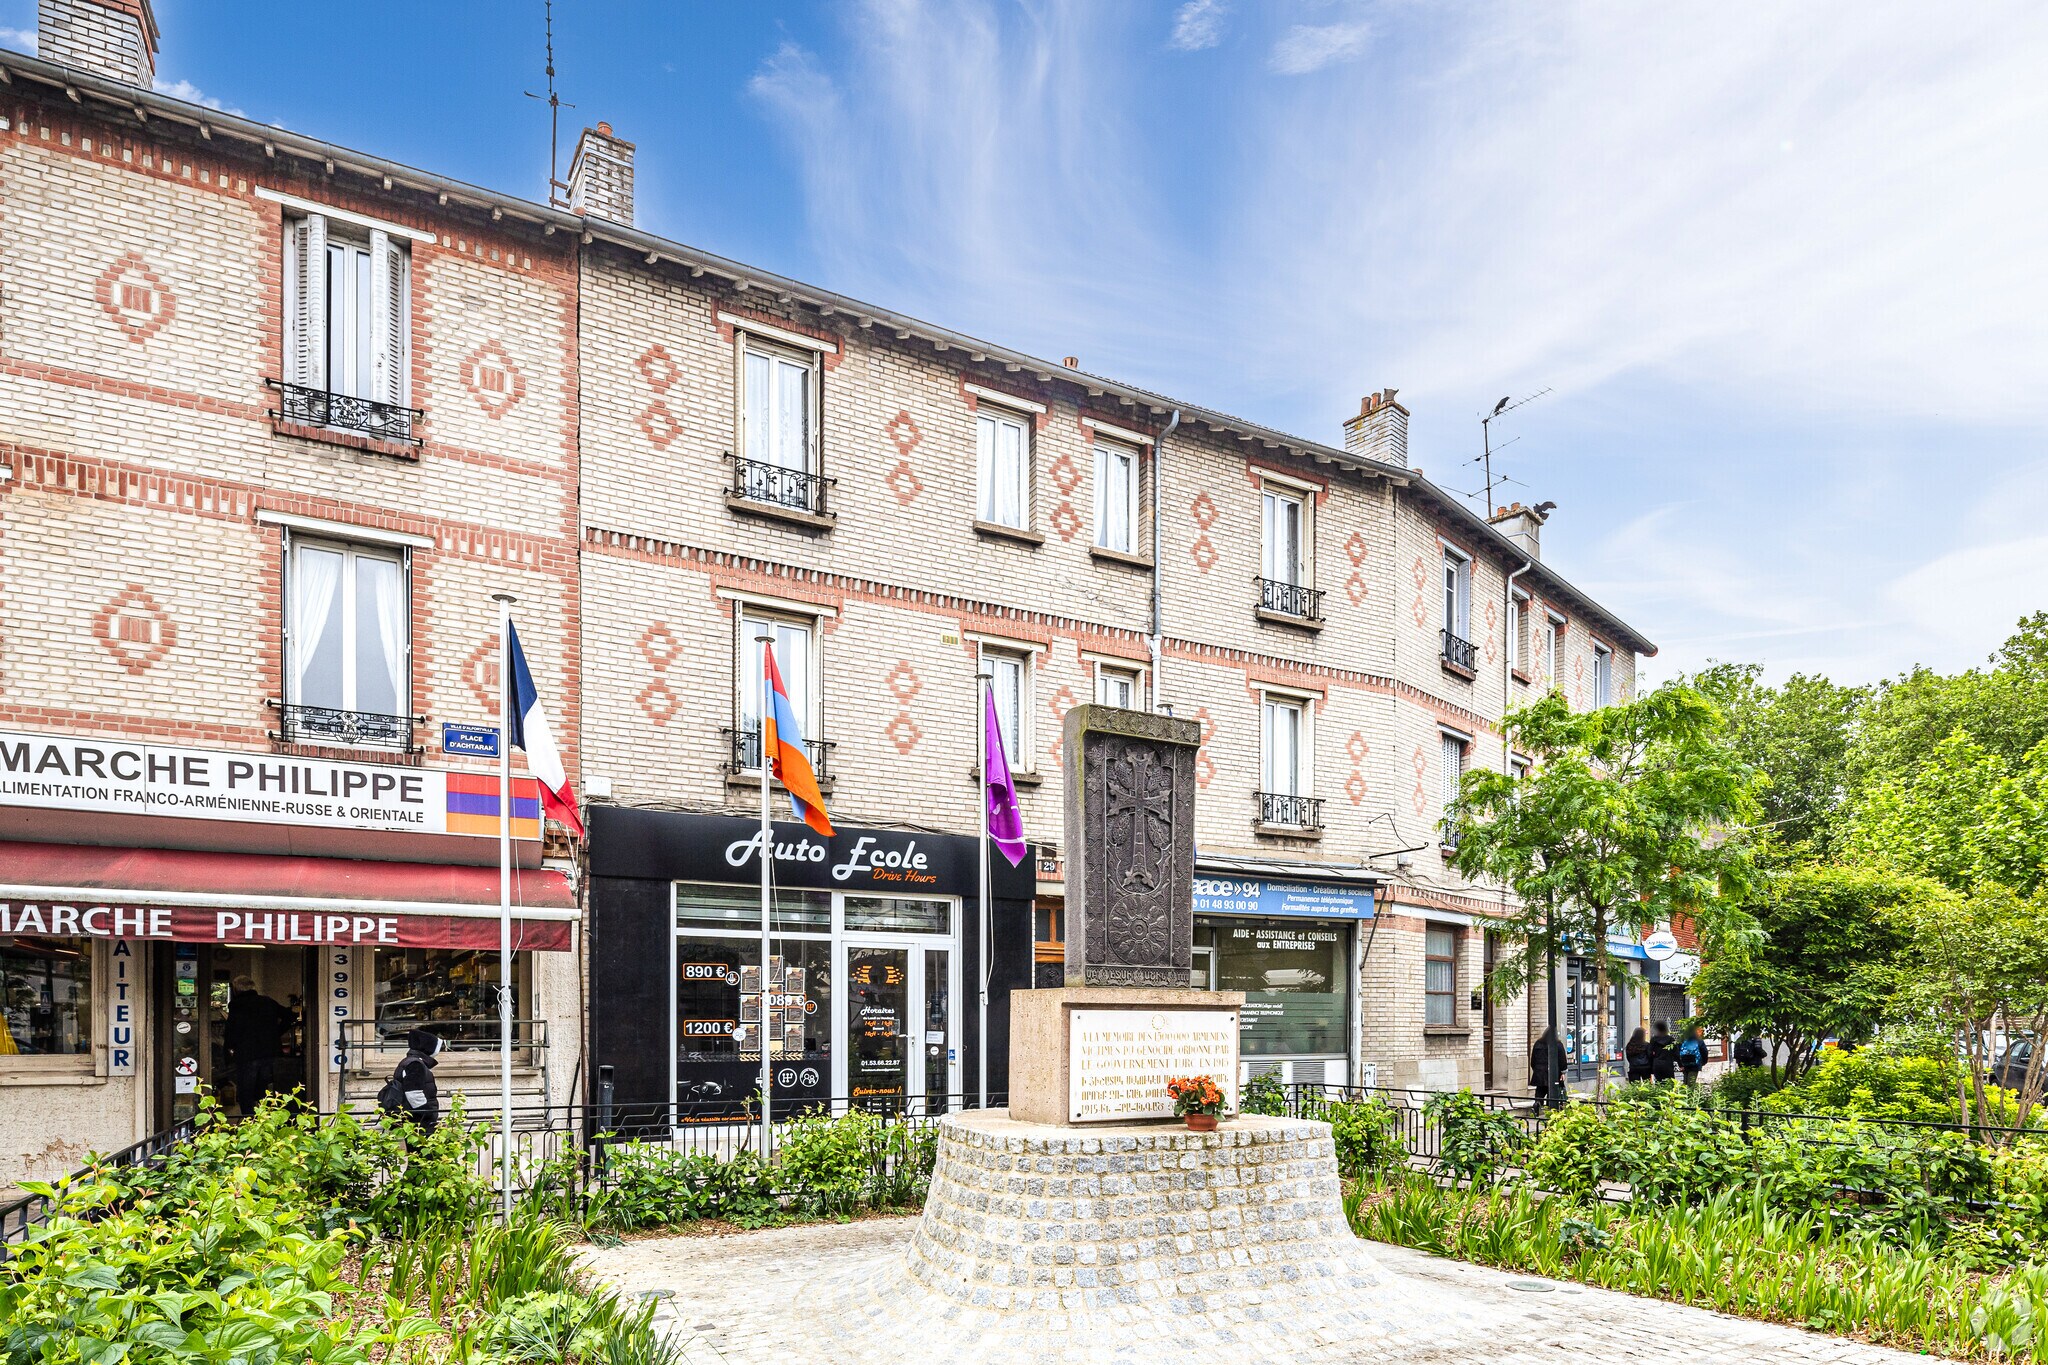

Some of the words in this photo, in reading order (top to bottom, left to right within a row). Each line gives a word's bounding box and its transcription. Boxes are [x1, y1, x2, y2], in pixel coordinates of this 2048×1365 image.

[449, 742, 494, 751] D'ACHTARAK
[0, 740, 210, 787] MARCHE
[228, 760, 424, 804] PHILIPPE
[0, 780, 109, 801] LIMENTATION
[113, 788, 333, 817] FRANCO-ARMÉNIENNE-RUSSE
[336, 805, 346, 818] &
[350, 806, 424, 823] ORIENTALE
[725, 829, 827, 868] Auto
[831, 836, 928, 882] Ecole
[1043, 861, 1055, 871] 29
[873, 868, 902, 882] Drive
[904, 870, 937, 884] Hours
[1267, 882, 1308, 894] Domiciliation
[1312, 885, 1338, 895] Création
[1339, 888, 1347, 896] de
[1348, 889, 1372, 897] sociétés
[1200, 898, 1210, 909] 01
[1212, 899, 1223, 909] 48
[1223, 900, 1235, 910] 93
[1236, 900, 1247, 910] 00
[1247, 901, 1258, 911] 90
[1286, 894, 1320, 904] Permanence
[1320, 896, 1354, 906] téléphonique
[1281, 903, 1310, 912] Formalités
[1310, 905, 1329, 914] auprès
[1339, 907, 1359, 915] greffes
[216, 911, 399, 944] PHILIPPE
[1232, 928, 1250, 939] AIDE
[1256, 929, 1296, 940] ASSISTANCE
[1297, 933, 1306, 941] et
[1307, 931, 1338, 942] CONSEILS
[1256, 940, 1271, 949] aux
[1272, 940, 1316, 951] ENTREPRISES
[686, 965, 713, 978] 890
[716, 966, 726, 978] €
[768, 995, 792, 1006] 089
[796, 995, 805, 1006] €
[860, 1005, 895, 1016] Horaires
[685, 1022, 721, 1035] 1200
[723, 1023, 733, 1035] €
[1081, 1045, 1121, 1056] VICTIMES
[1137, 1044, 1176, 1056] GENOCIDE
[1178, 1044, 1213, 1055] ORDONNE
[1215, 1044, 1230, 1055] PAR
[1081, 1058, 1092, 1071] LE
[1096, 1058, 1170, 1070] GOUVERNEMENT
[1173, 1058, 1194, 1069] TURC
[1199, 1058, 1211, 1068] EN
[853, 1086, 895, 1097] Suivez-nous
